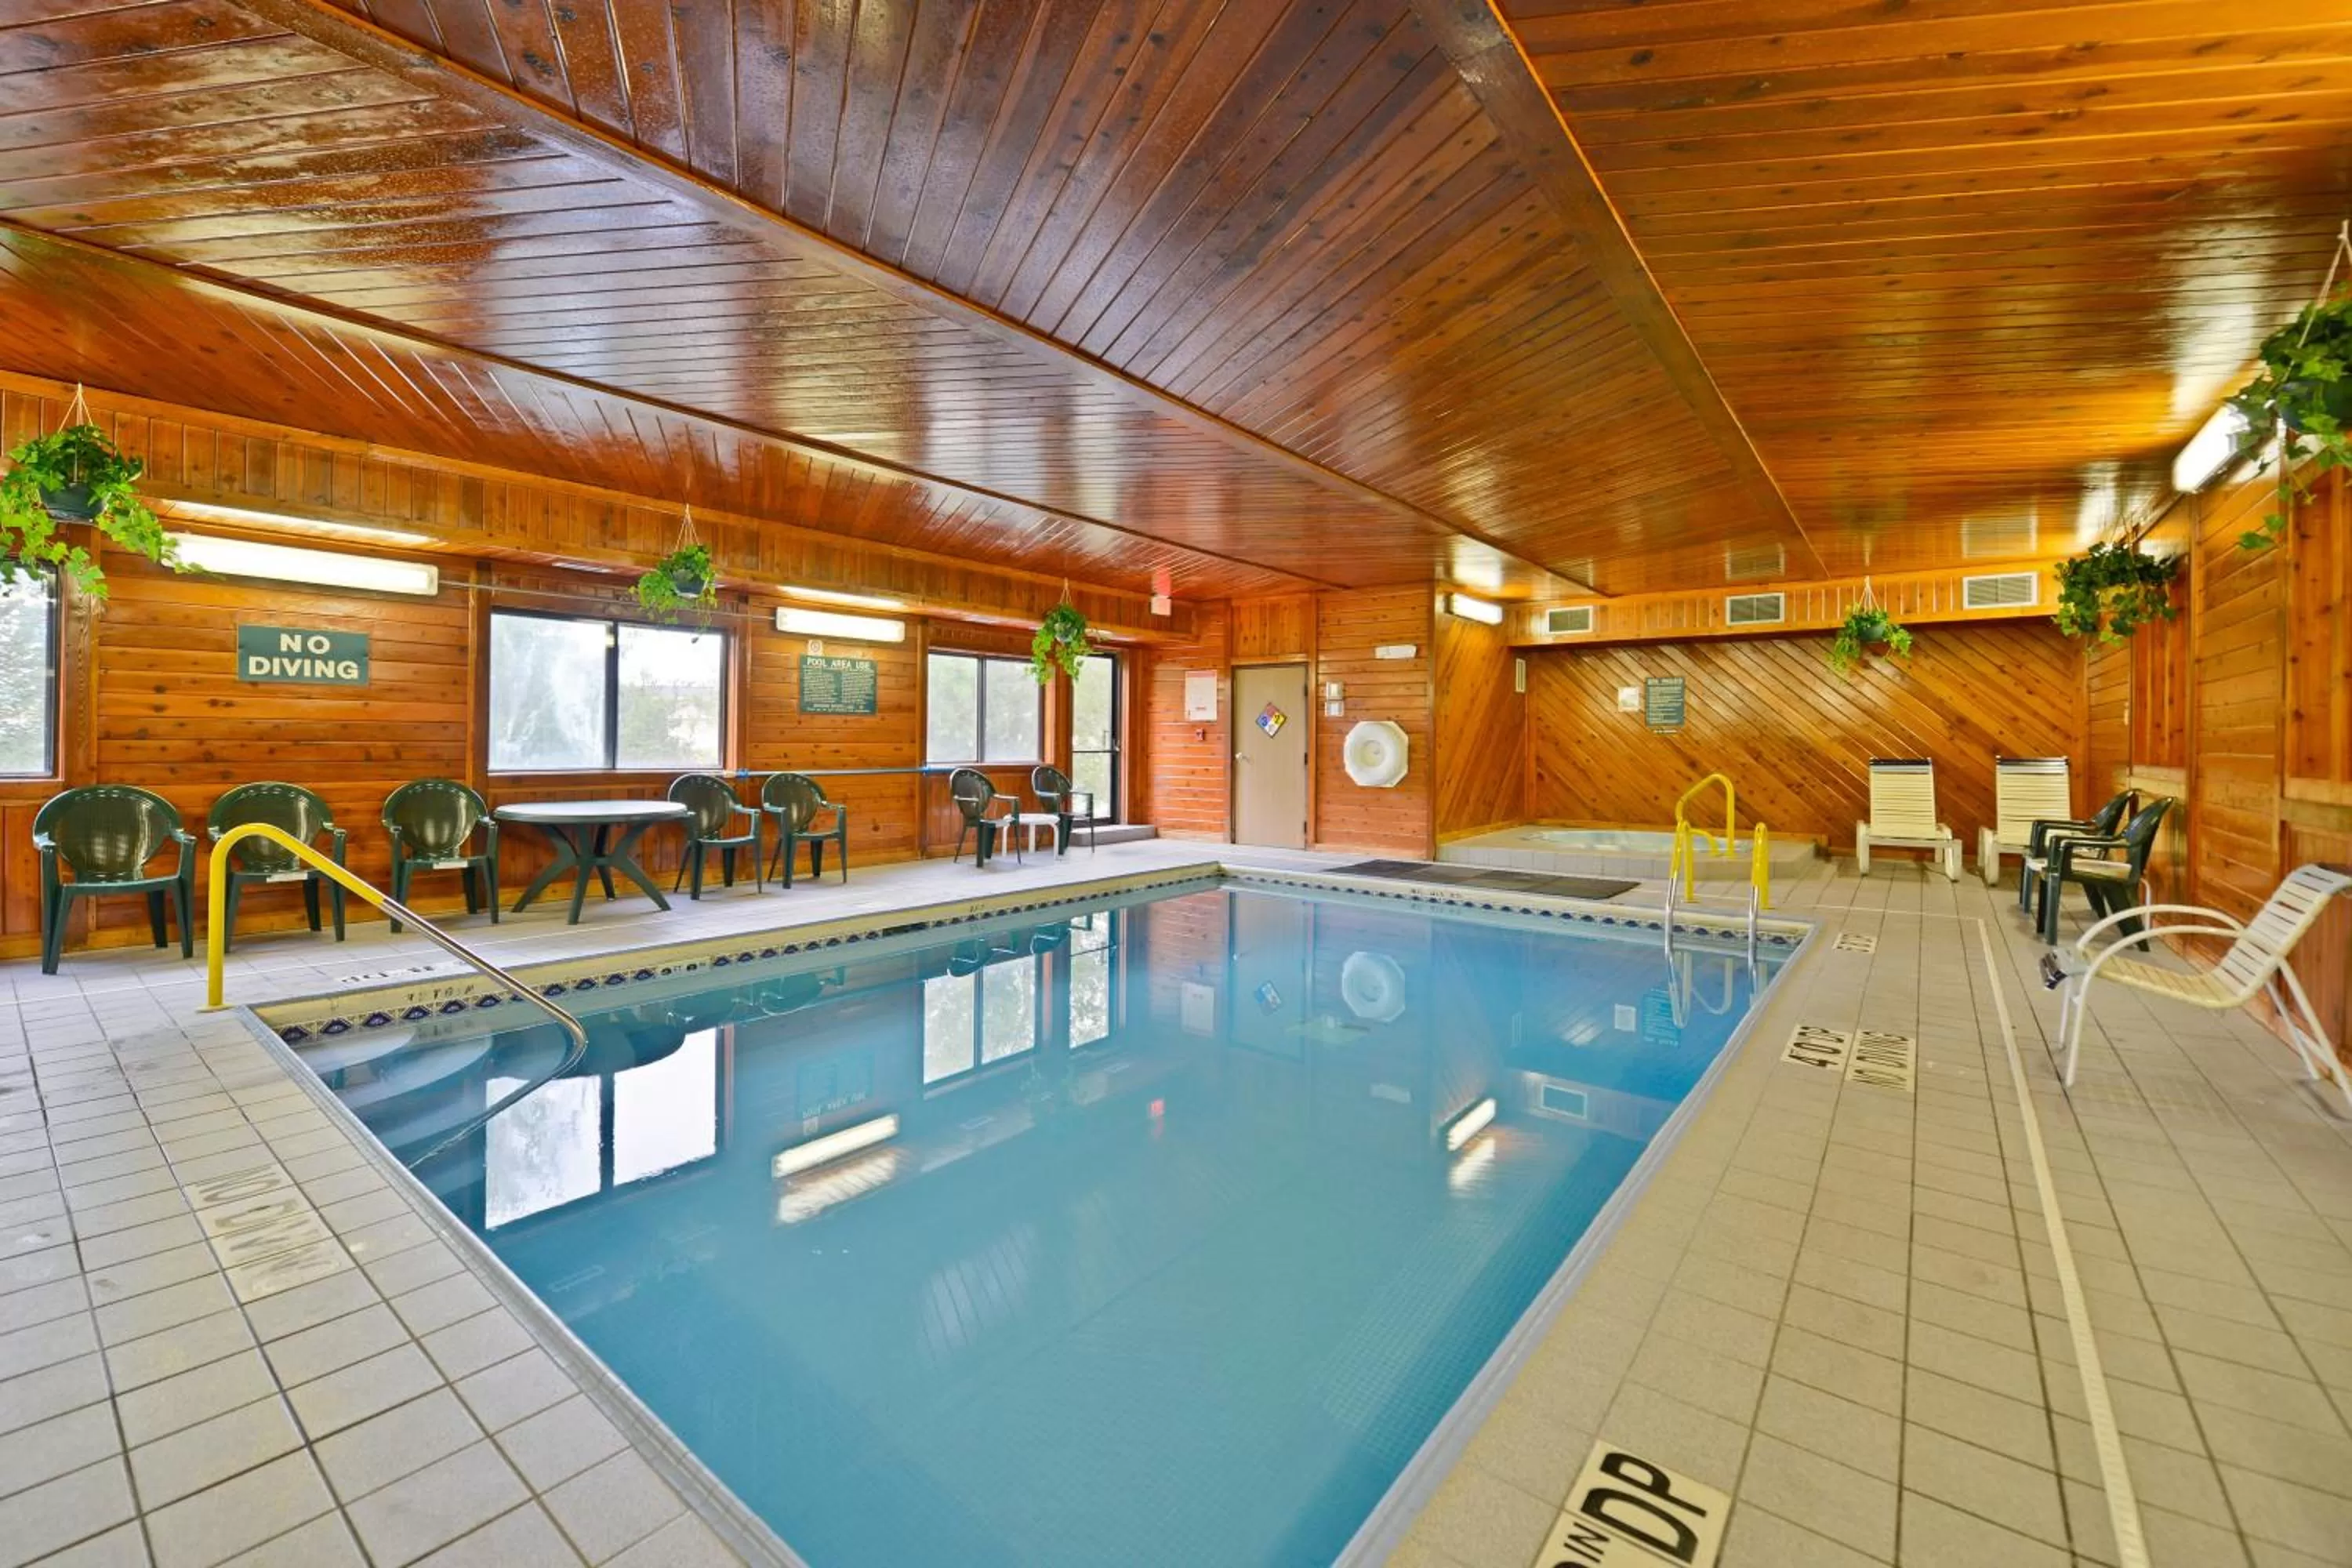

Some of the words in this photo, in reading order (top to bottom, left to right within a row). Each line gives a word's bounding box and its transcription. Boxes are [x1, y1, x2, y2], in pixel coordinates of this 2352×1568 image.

[280, 633, 330, 655] NO
[249, 656, 358, 680] DIVING
[807, 657, 826, 666] POOL
[831, 659, 852, 670] AREA
[1580, 1452, 1708, 1565] DP
[1563, 1522, 1610, 1563] IN
